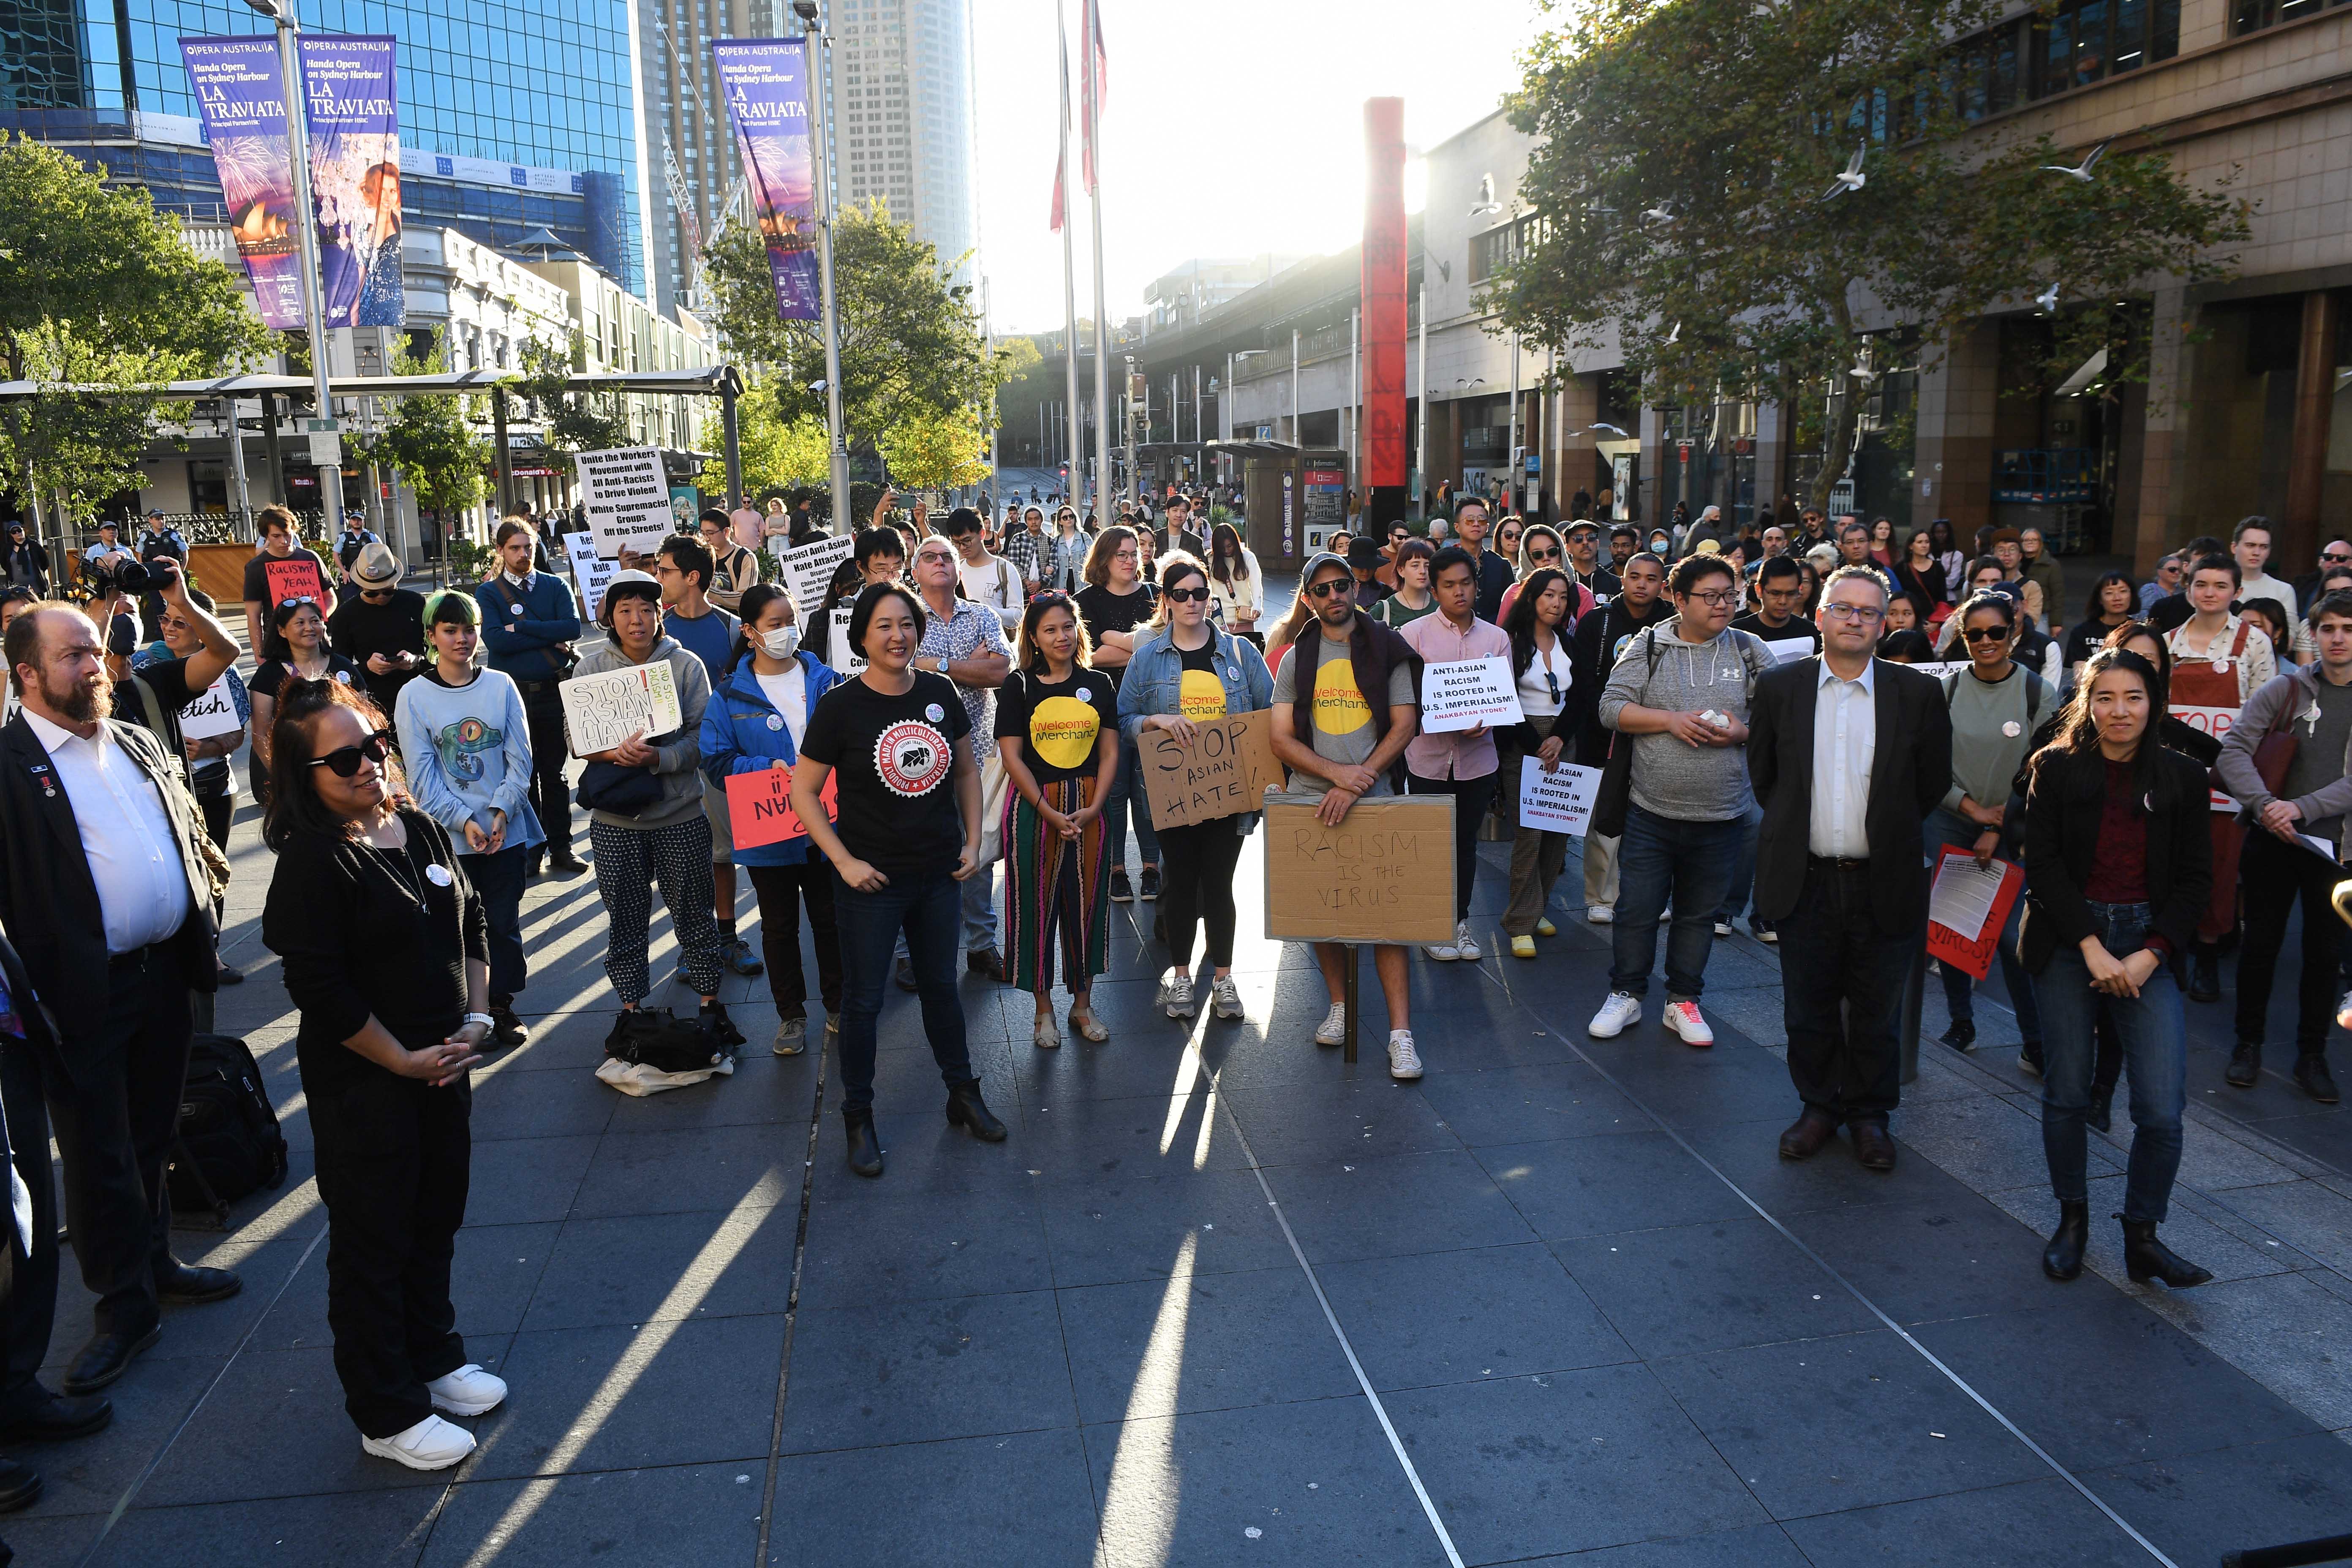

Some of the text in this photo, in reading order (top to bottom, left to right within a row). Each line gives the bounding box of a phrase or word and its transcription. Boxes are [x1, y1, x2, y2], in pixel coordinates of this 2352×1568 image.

[193, 63, 246, 72] Handa Opera
[307, 60, 360, 69] Handa Opera
[722, 65, 771, 74] Handa Opera
[208, 74, 235, 84] Sydney
[237, 73, 270, 81] Harbour
[320, 70, 348, 80] Sydney
[351, 70, 383, 79] Harbour
[734, 74, 760, 84] Sydney
[762, 74, 794, 83] Harbour
[199, 85, 226, 101] LA
[308, 81, 334, 97] LA
[205, 101, 286, 119] TRAVIATA
[310, 99, 394, 115] TRAVIATA
[581, 456, 603, 464] Unite
[620, 451, 656, 460] Workers
[589, 463, 652, 475] Movement with
[605, 475, 655, 486] Anti-Racists
[604, 489, 626, 498] Drive
[628, 486, 657, 495] Violent
[590, 499, 668, 514] White Supremacist
[617, 514, 646, 524] Groups
[604, 528, 615, 536] Off
[632, 523, 664, 534] Streets!
[580, 536, 593, 545] Res
[782, 539, 851, 563] Resist Anti-Asian
[592, 563, 610, 572] Hate
[793, 551, 847, 572] Hate Attacks!
[267, 563, 313, 575] Racism?
[1433, 664, 1486, 675] ANTI-ASIAN
[1444, 676, 1480, 686] RACISM
[659, 664, 676, 724] END SYSTEMATIC
[1446, 688, 1484, 697] ROOTED
[1179, 696, 1220, 705] elcome
[1446, 695, 1514, 709] IMPERIALISM!
[579, 691, 653, 728] ASIAN
[1179, 705, 1226, 716] erchant
[1435, 710, 1478, 720] ANAKBAYAN
[1034, 720, 1091, 732] Welcome
[1036, 728, 1095, 742] Merchant
[899, 740, 911, 749] ELEFANT
[1157, 721, 1247, 771] STOP
[882, 727, 947, 789] PROUDLY MADE IN MULTICULTURAL AUSTRALIA
[1187, 759, 1233, 786] ASIAN
[1538, 764, 1582, 778] A-ASIAN
[1543, 777, 1572, 787] RACISM
[1540, 789, 1569, 799] ROOTED
[1523, 798, 1588, 814] U.S. IMPERIALISM!
[1527, 810, 1554, 818] ANAKBAYAN
[1293, 829, 1418, 862] RACISM
[1337, 865, 1406, 881] IS THE
[1318, 885, 1399, 909] VIRUS
